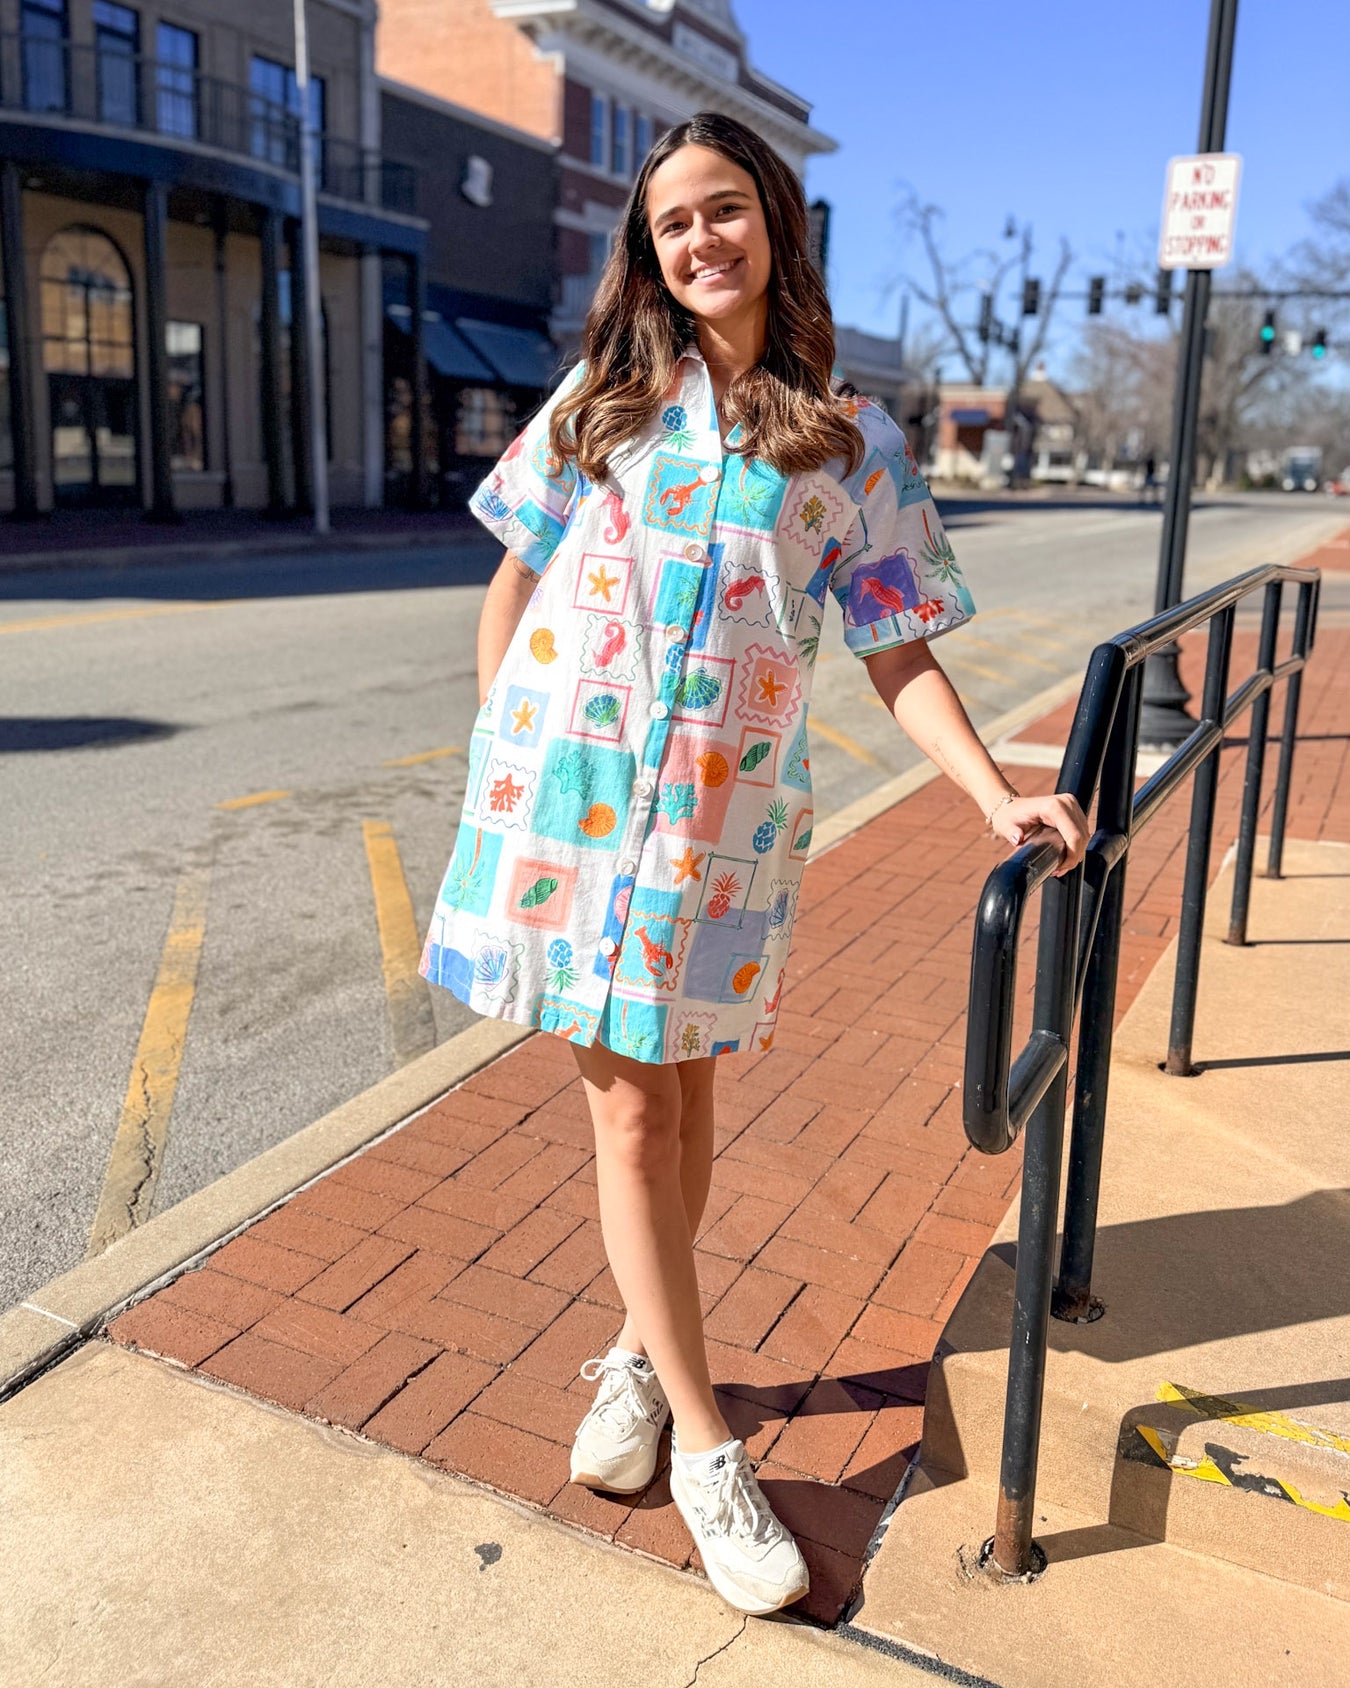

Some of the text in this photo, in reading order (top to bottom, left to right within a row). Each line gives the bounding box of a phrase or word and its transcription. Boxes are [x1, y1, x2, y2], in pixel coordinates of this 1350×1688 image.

[1192, 164, 1216, 186] NO
[1169, 190, 1230, 211] PARKING
[1191, 214, 1207, 231] OR
[1164, 235, 1227, 256] STOPPING
